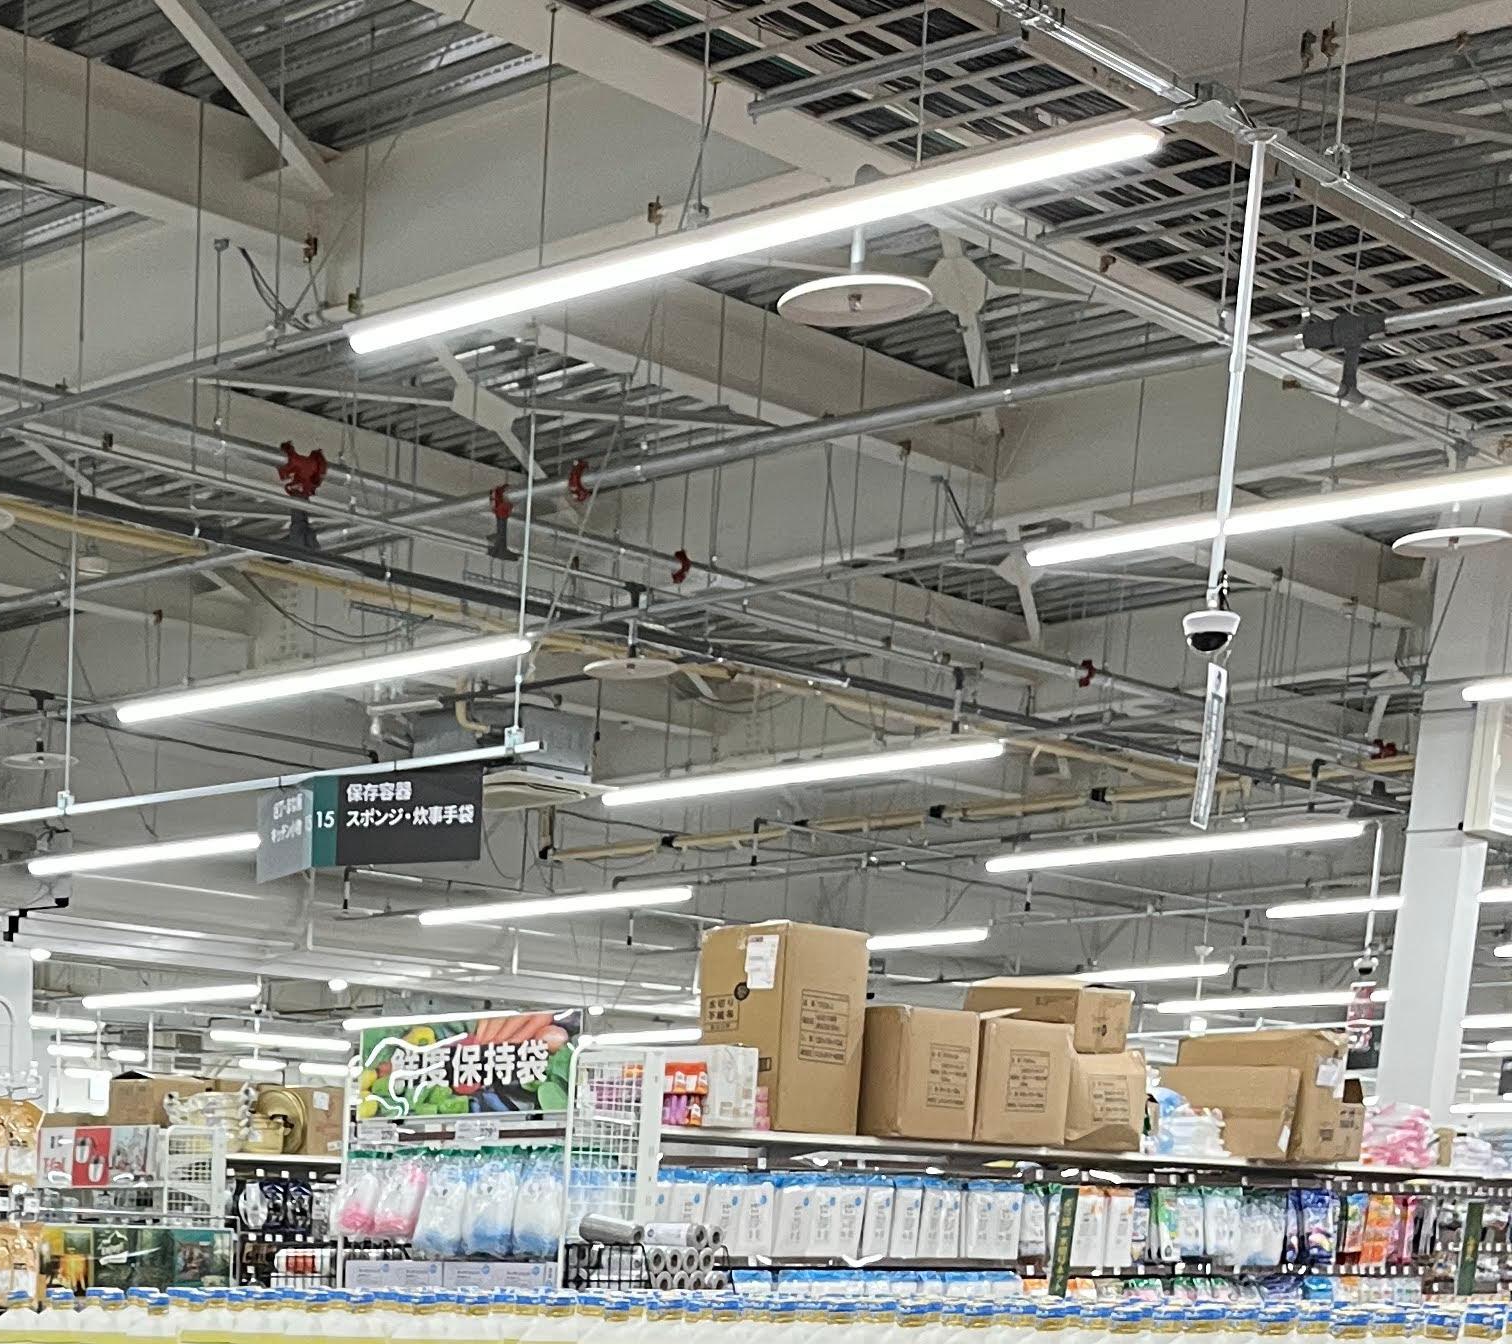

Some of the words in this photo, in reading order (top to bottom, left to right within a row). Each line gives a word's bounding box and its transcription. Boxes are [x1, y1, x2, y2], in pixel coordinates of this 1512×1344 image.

[346, 781, 412, 802] 保存容器
[316, 811, 335, 829] 15
[346, 804, 474, 827] スポンジ・炊事手袋
